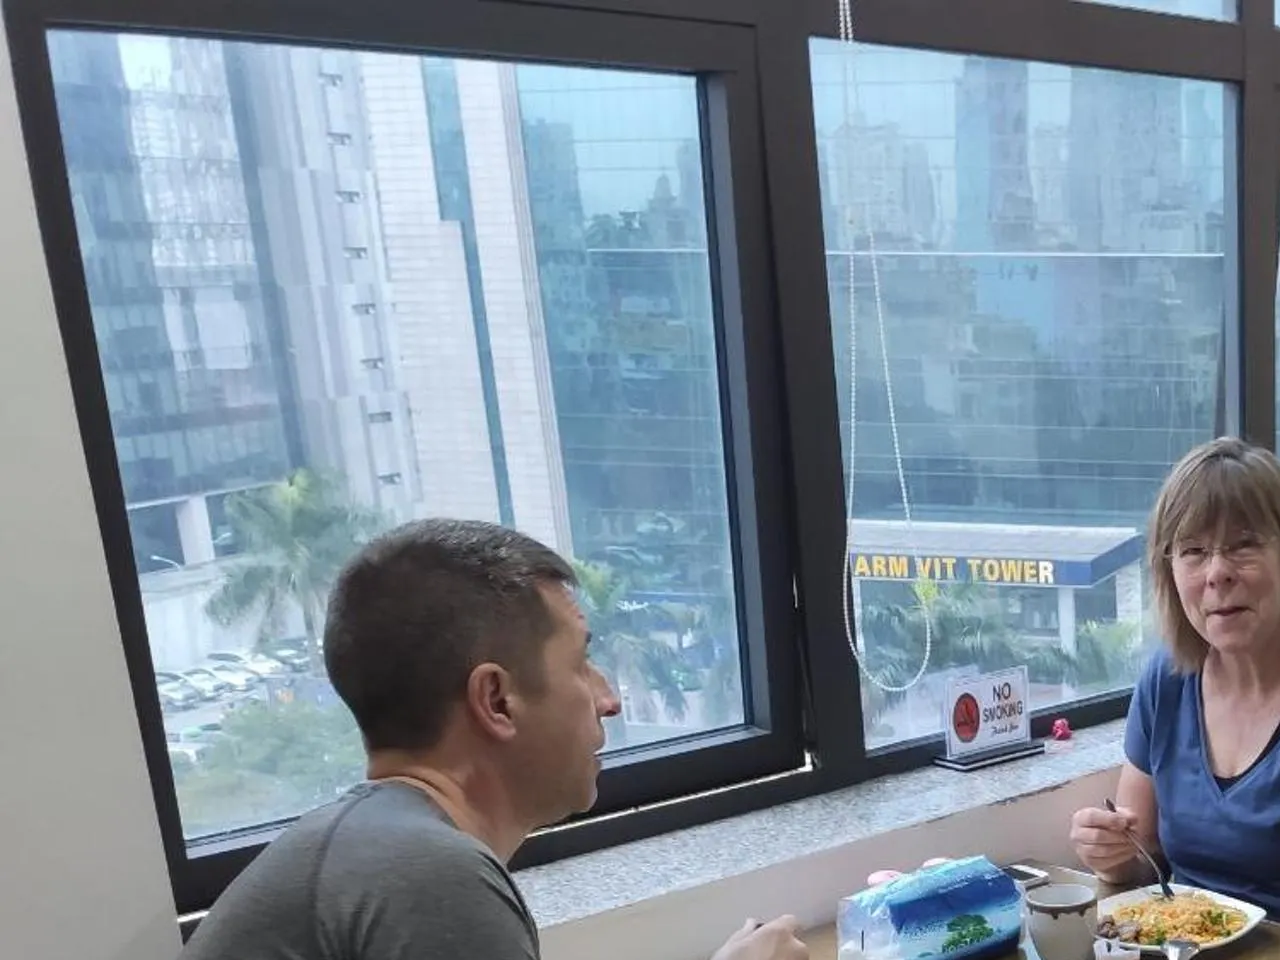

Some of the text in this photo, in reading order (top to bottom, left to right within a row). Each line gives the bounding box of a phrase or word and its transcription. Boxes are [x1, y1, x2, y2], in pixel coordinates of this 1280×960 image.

[854, 555, 1053, 584] ARM VIT TOWER
[993, 682, 1011, 701] NO
[982, 700, 1023, 723] SMOKING
